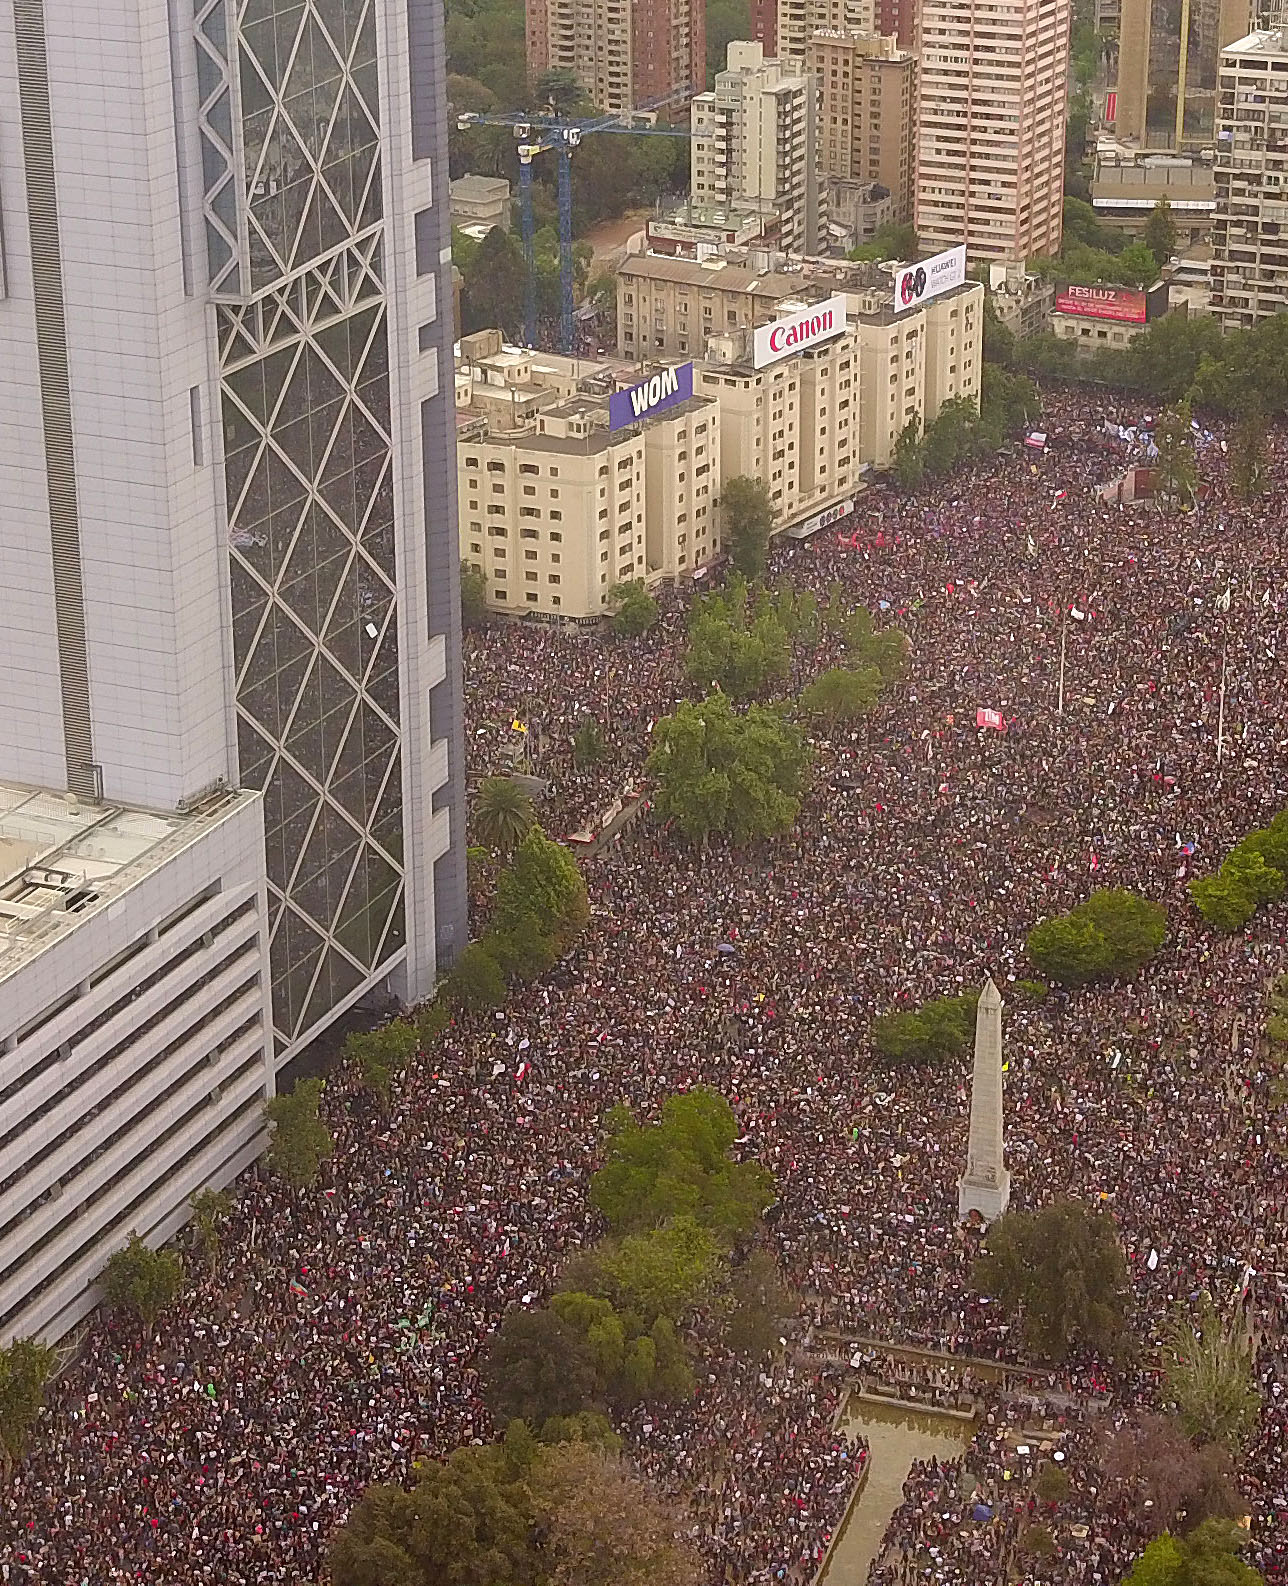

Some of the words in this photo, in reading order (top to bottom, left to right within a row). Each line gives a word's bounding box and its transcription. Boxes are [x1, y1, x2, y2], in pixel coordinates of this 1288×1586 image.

[1068, 285, 1116, 301] FESILUZ
[769, 310, 833, 353] Canon
[630, 366, 679, 417] WOM
